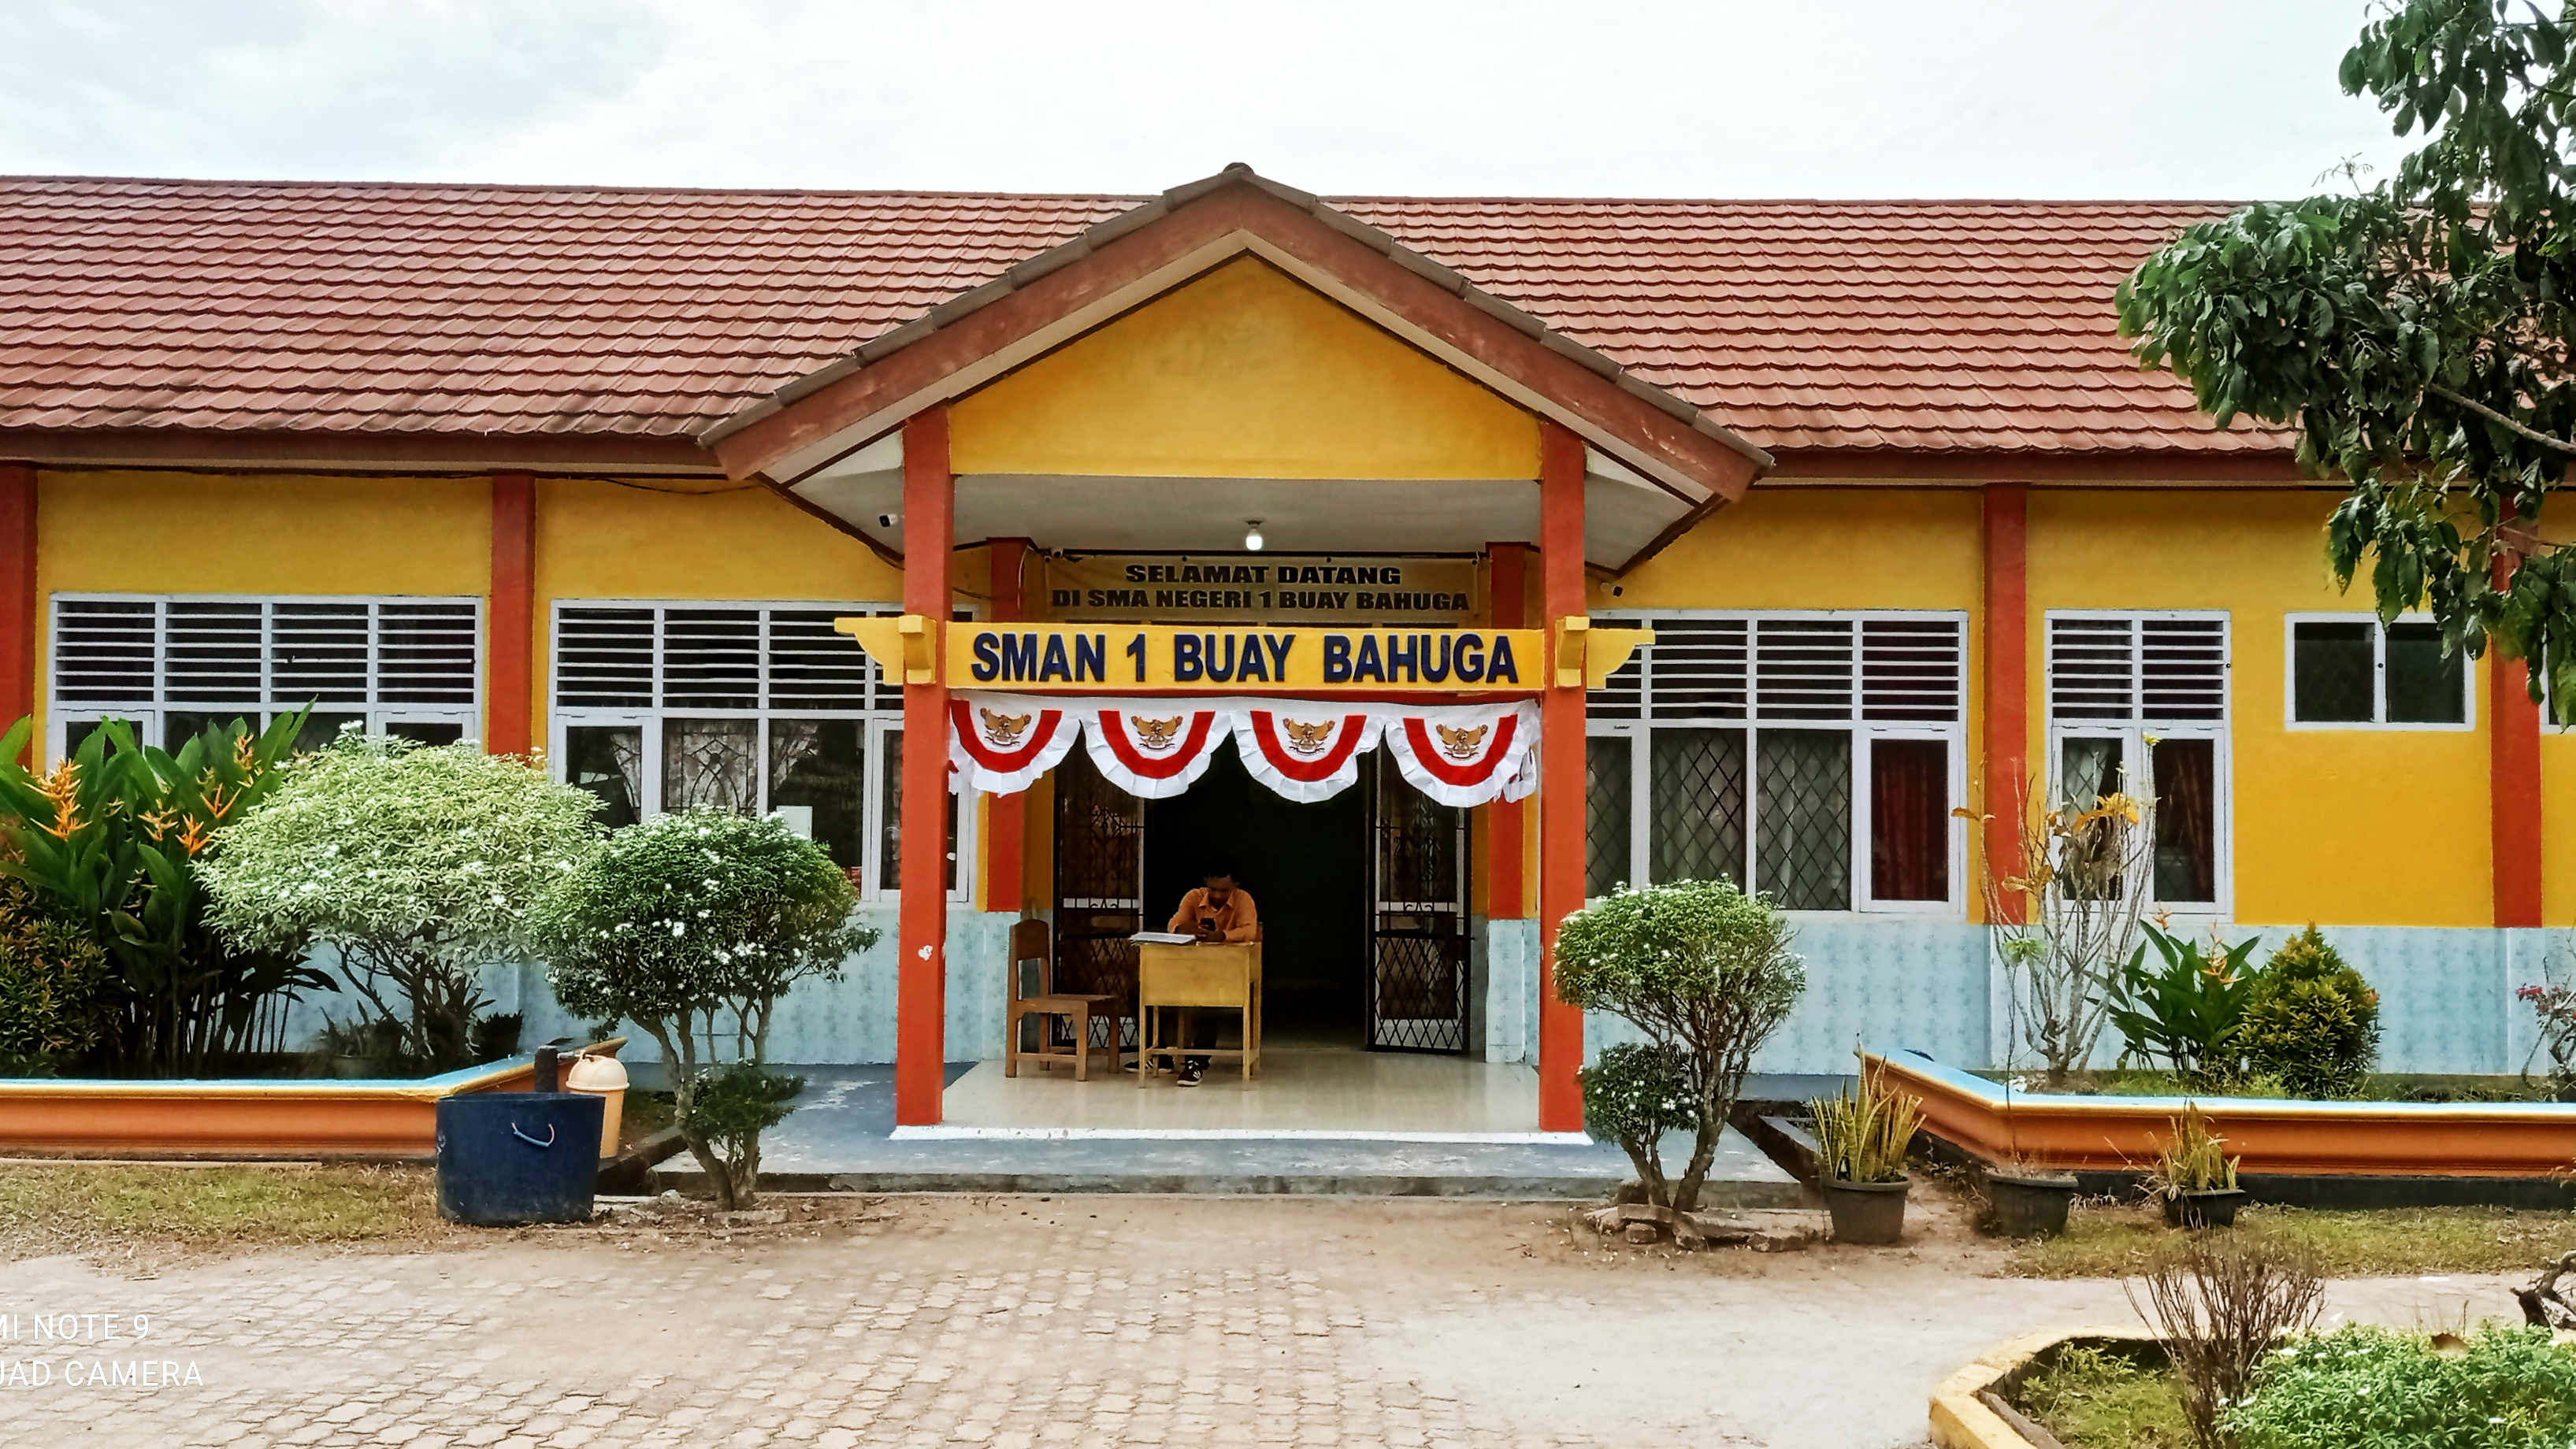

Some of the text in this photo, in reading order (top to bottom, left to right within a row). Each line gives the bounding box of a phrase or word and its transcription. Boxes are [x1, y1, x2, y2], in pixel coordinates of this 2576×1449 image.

[1126, 564, 1401, 584] SELAMAT DATANG
[1052, 589, 1469, 611] DI SMA NEGERI 1 BUAY BAHUGA
[971, 632, 1519, 684] SMAN 1 BUAY BAHUGA
